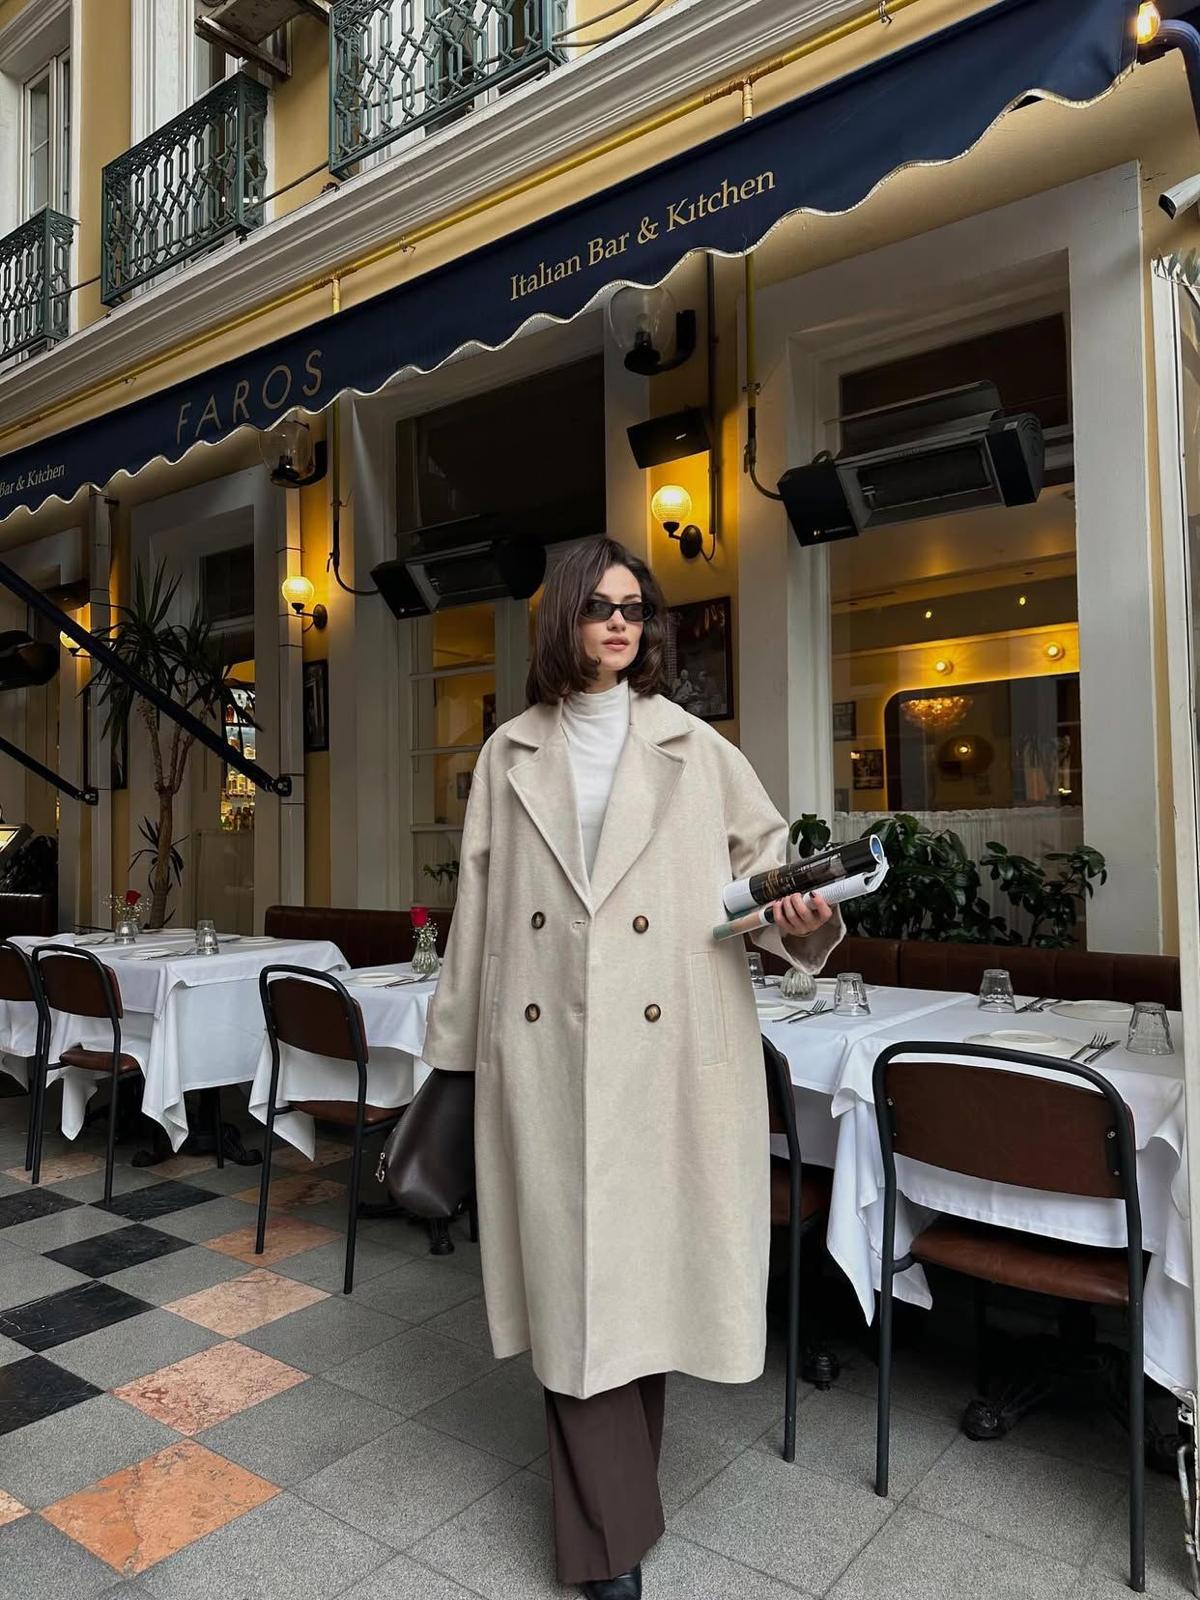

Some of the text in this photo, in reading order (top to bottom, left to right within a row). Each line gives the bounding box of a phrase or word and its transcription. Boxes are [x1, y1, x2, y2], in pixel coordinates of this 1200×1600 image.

[587, 231, 630, 266] Bar
[637, 216, 659, 244] &
[176, 350, 322, 444] FAROS
[16, 475, 25, 491] &
